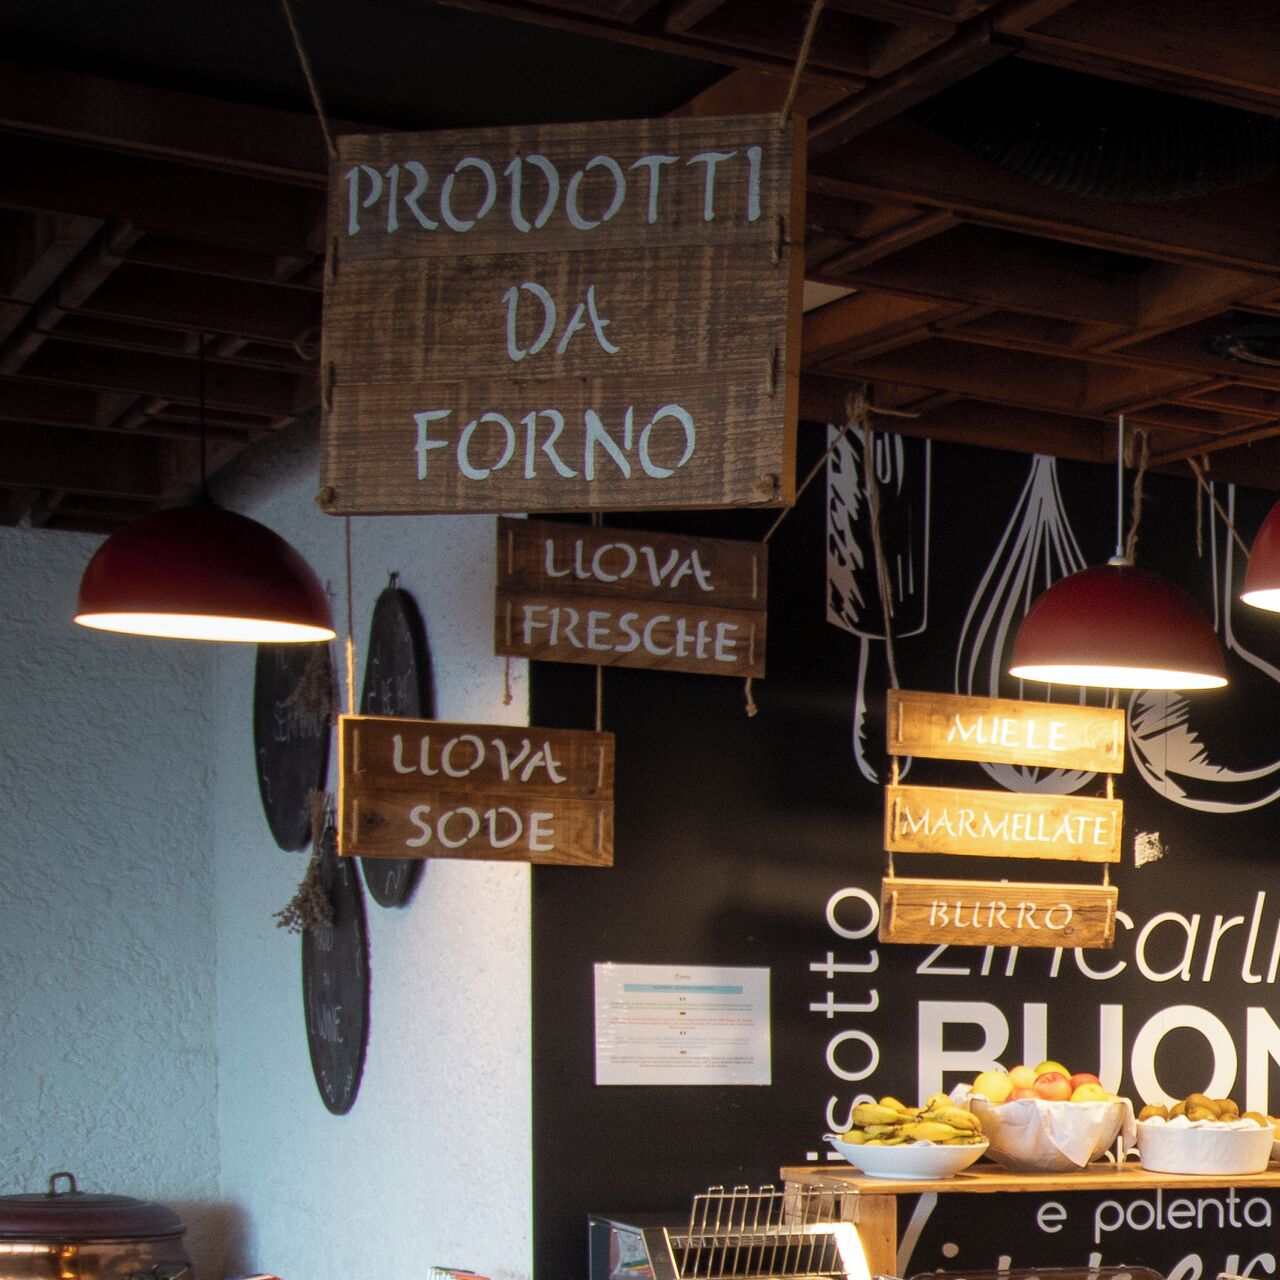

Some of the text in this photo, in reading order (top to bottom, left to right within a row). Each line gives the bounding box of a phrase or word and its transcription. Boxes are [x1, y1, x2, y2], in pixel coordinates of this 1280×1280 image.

[345, 146, 763, 236] PRODOTTI
[502, 282, 620, 361] DA
[413, 404, 696, 481] FORNO
[522, 605, 739, 662] FRESCHE
[947, 714, 1067, 750] MIELE
[405, 805, 555, 852] SODE
[901, 807, 1108, 845] MARMELLATE
[929, 900, 1073, 930] BURRO
[1036, 1187, 1273, 1244] e polenta
